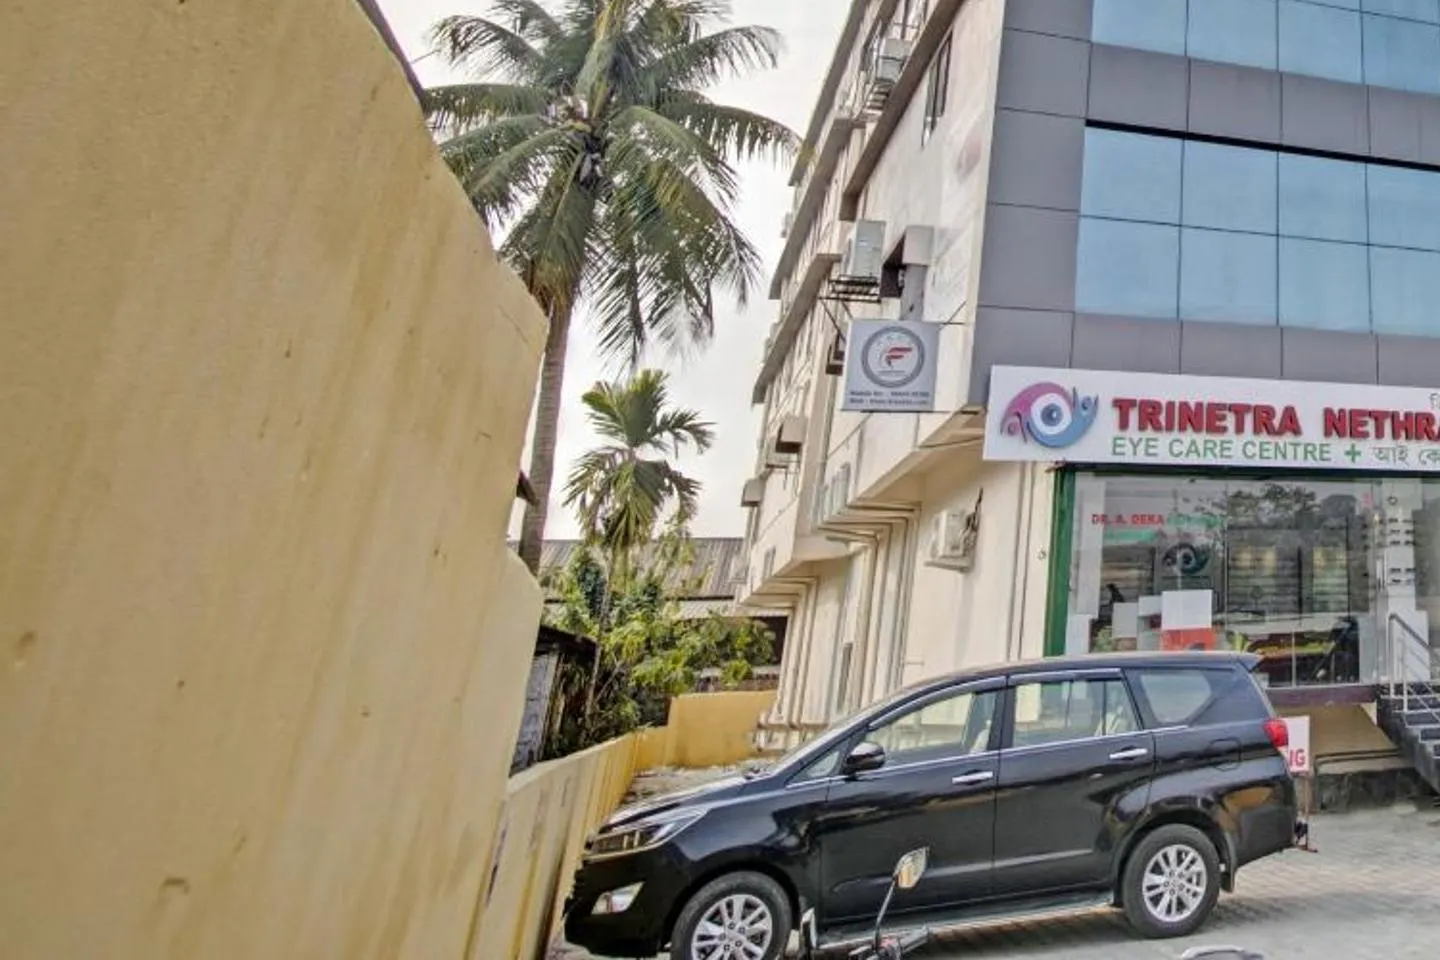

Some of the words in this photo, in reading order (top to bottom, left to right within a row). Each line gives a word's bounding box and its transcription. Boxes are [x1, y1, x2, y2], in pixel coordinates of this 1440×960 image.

[1112, 398, 1303, 437] TRINETRA
[1112, 437, 1159, 457] EYE
[1169, 439, 1235, 459] CARE
[1242, 441, 1333, 461] CENTRE
